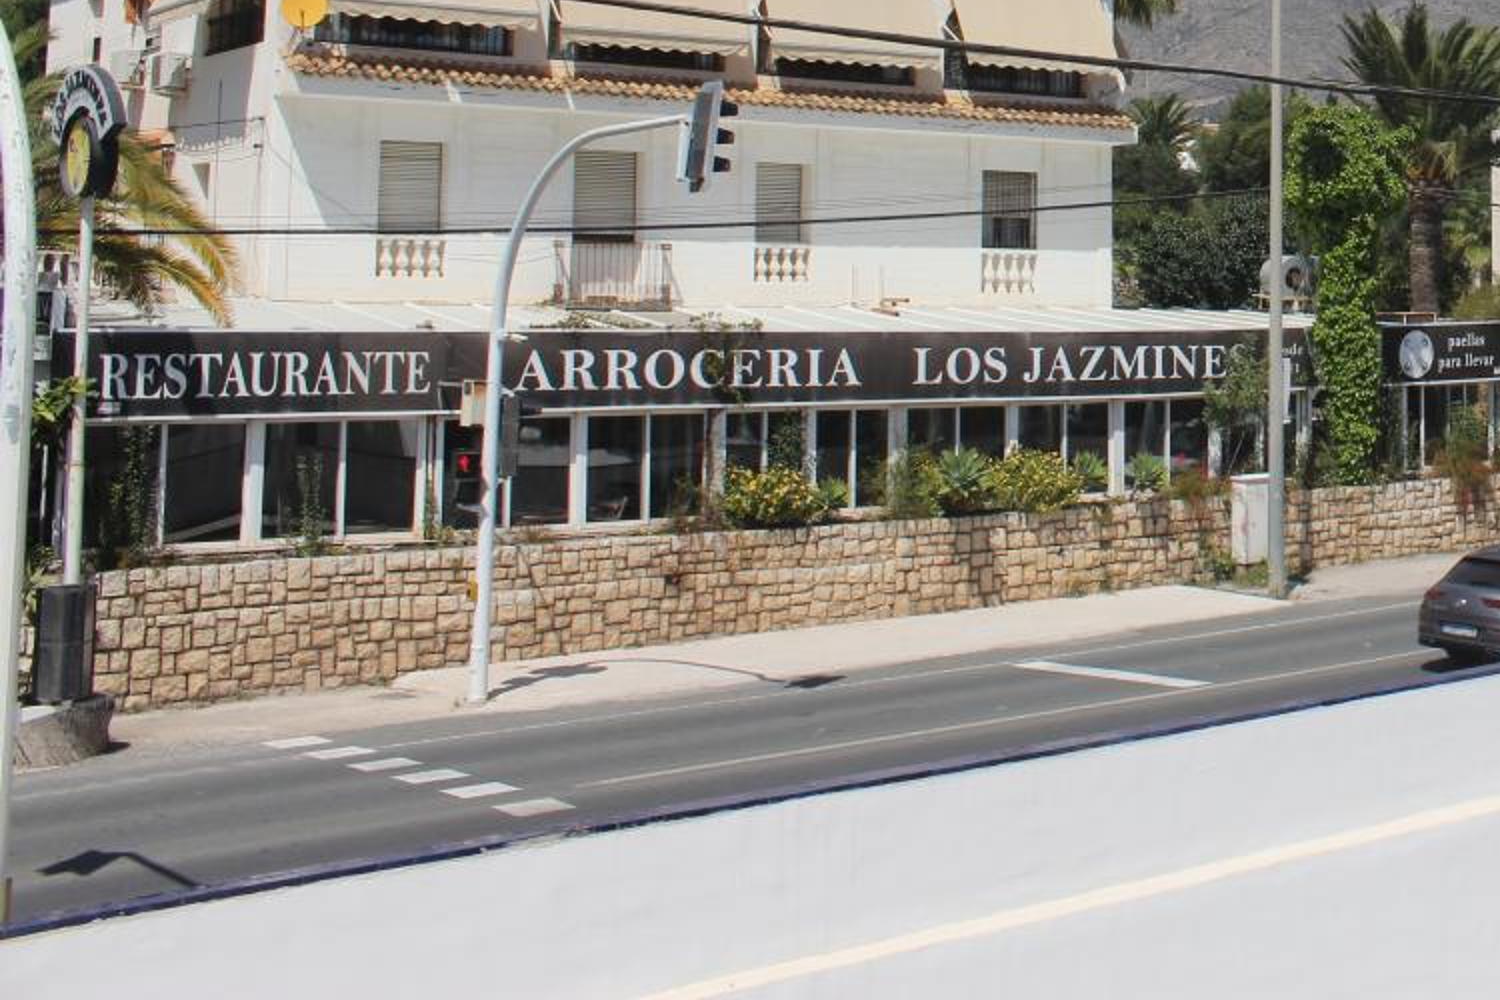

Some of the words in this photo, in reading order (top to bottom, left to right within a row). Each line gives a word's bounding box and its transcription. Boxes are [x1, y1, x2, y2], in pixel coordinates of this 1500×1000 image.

[1447, 332, 1486, 352] paellas
[99, 351, 432, 400] RESTAURANTE
[514, 347, 863, 391] ARROCERIA
[911, 346, 1008, 385] LOS
[1438, 357, 1461, 373] para
[1465, 353, 1495, 367] llevar
